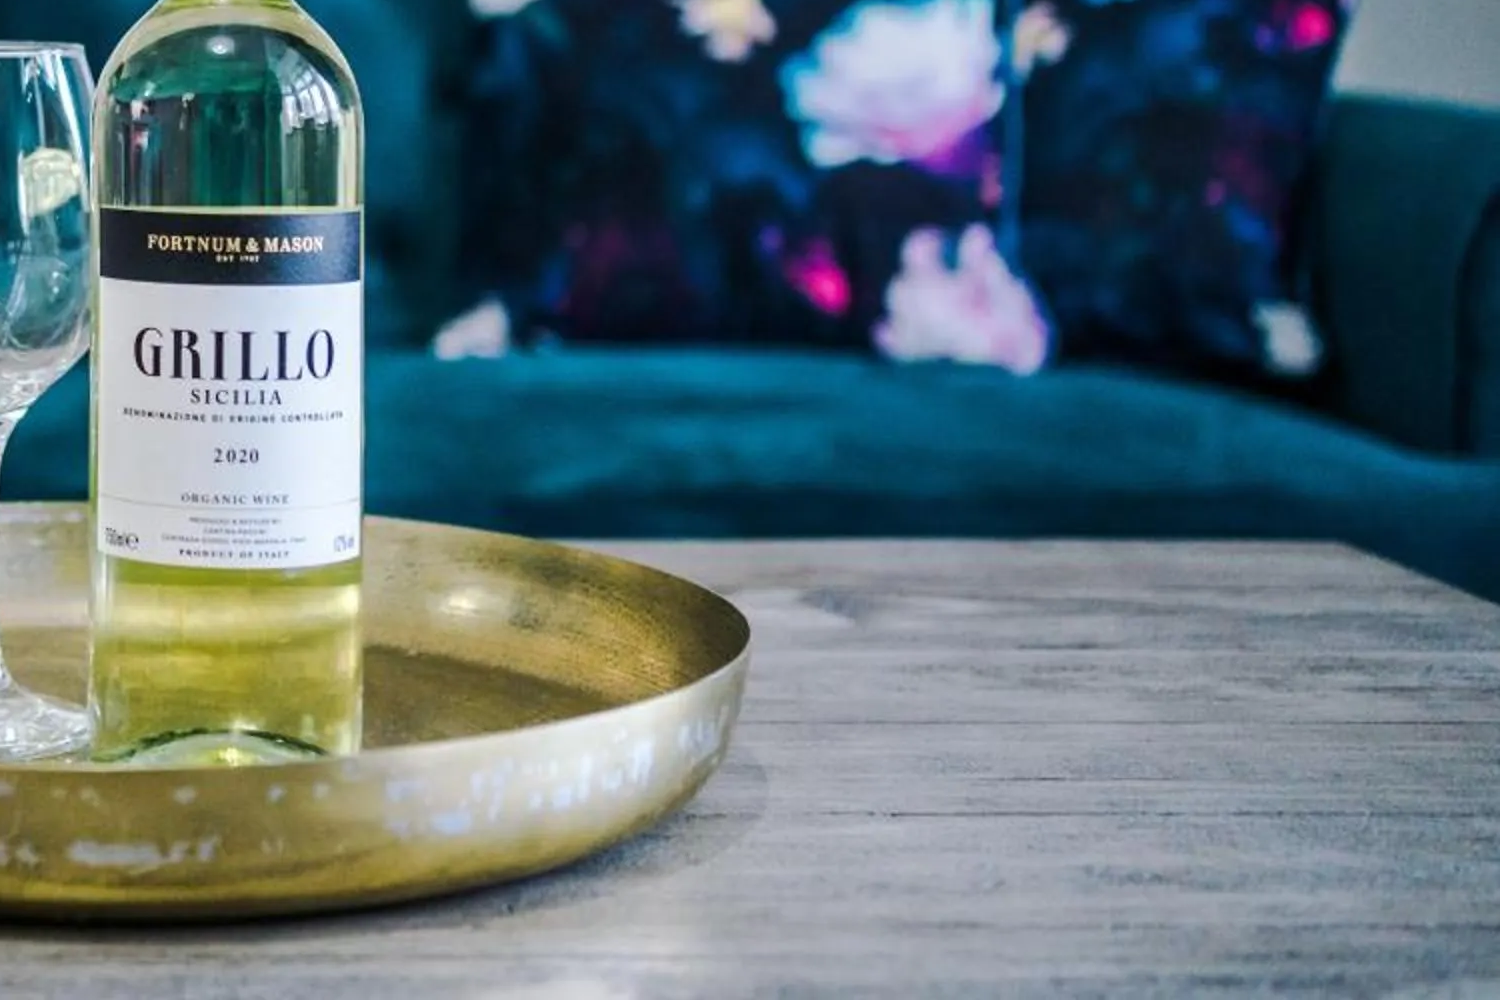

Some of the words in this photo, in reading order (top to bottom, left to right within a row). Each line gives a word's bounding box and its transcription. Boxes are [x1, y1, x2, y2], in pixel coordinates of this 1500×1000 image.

[147, 233, 242, 253] FORTNUM
[245, 236, 260, 253] &
[263, 235, 326, 254] MASON
[133, 326, 335, 381] GRILLO
[189, 388, 283, 406] SICILIA
[122, 406, 206, 424] DENOMINAZIONE
[211, 413, 224, 424] DI
[229, 413, 276, 424] ORIGINE
[213, 446, 260, 464] 2020
[180, 492, 248, 505] ORGANIC
[252, 493, 290, 505] WINE
[179, 548, 234, 559] PRODUCT
[239, 550, 254, 560] OF
[258, 550, 290, 560] ITALY
